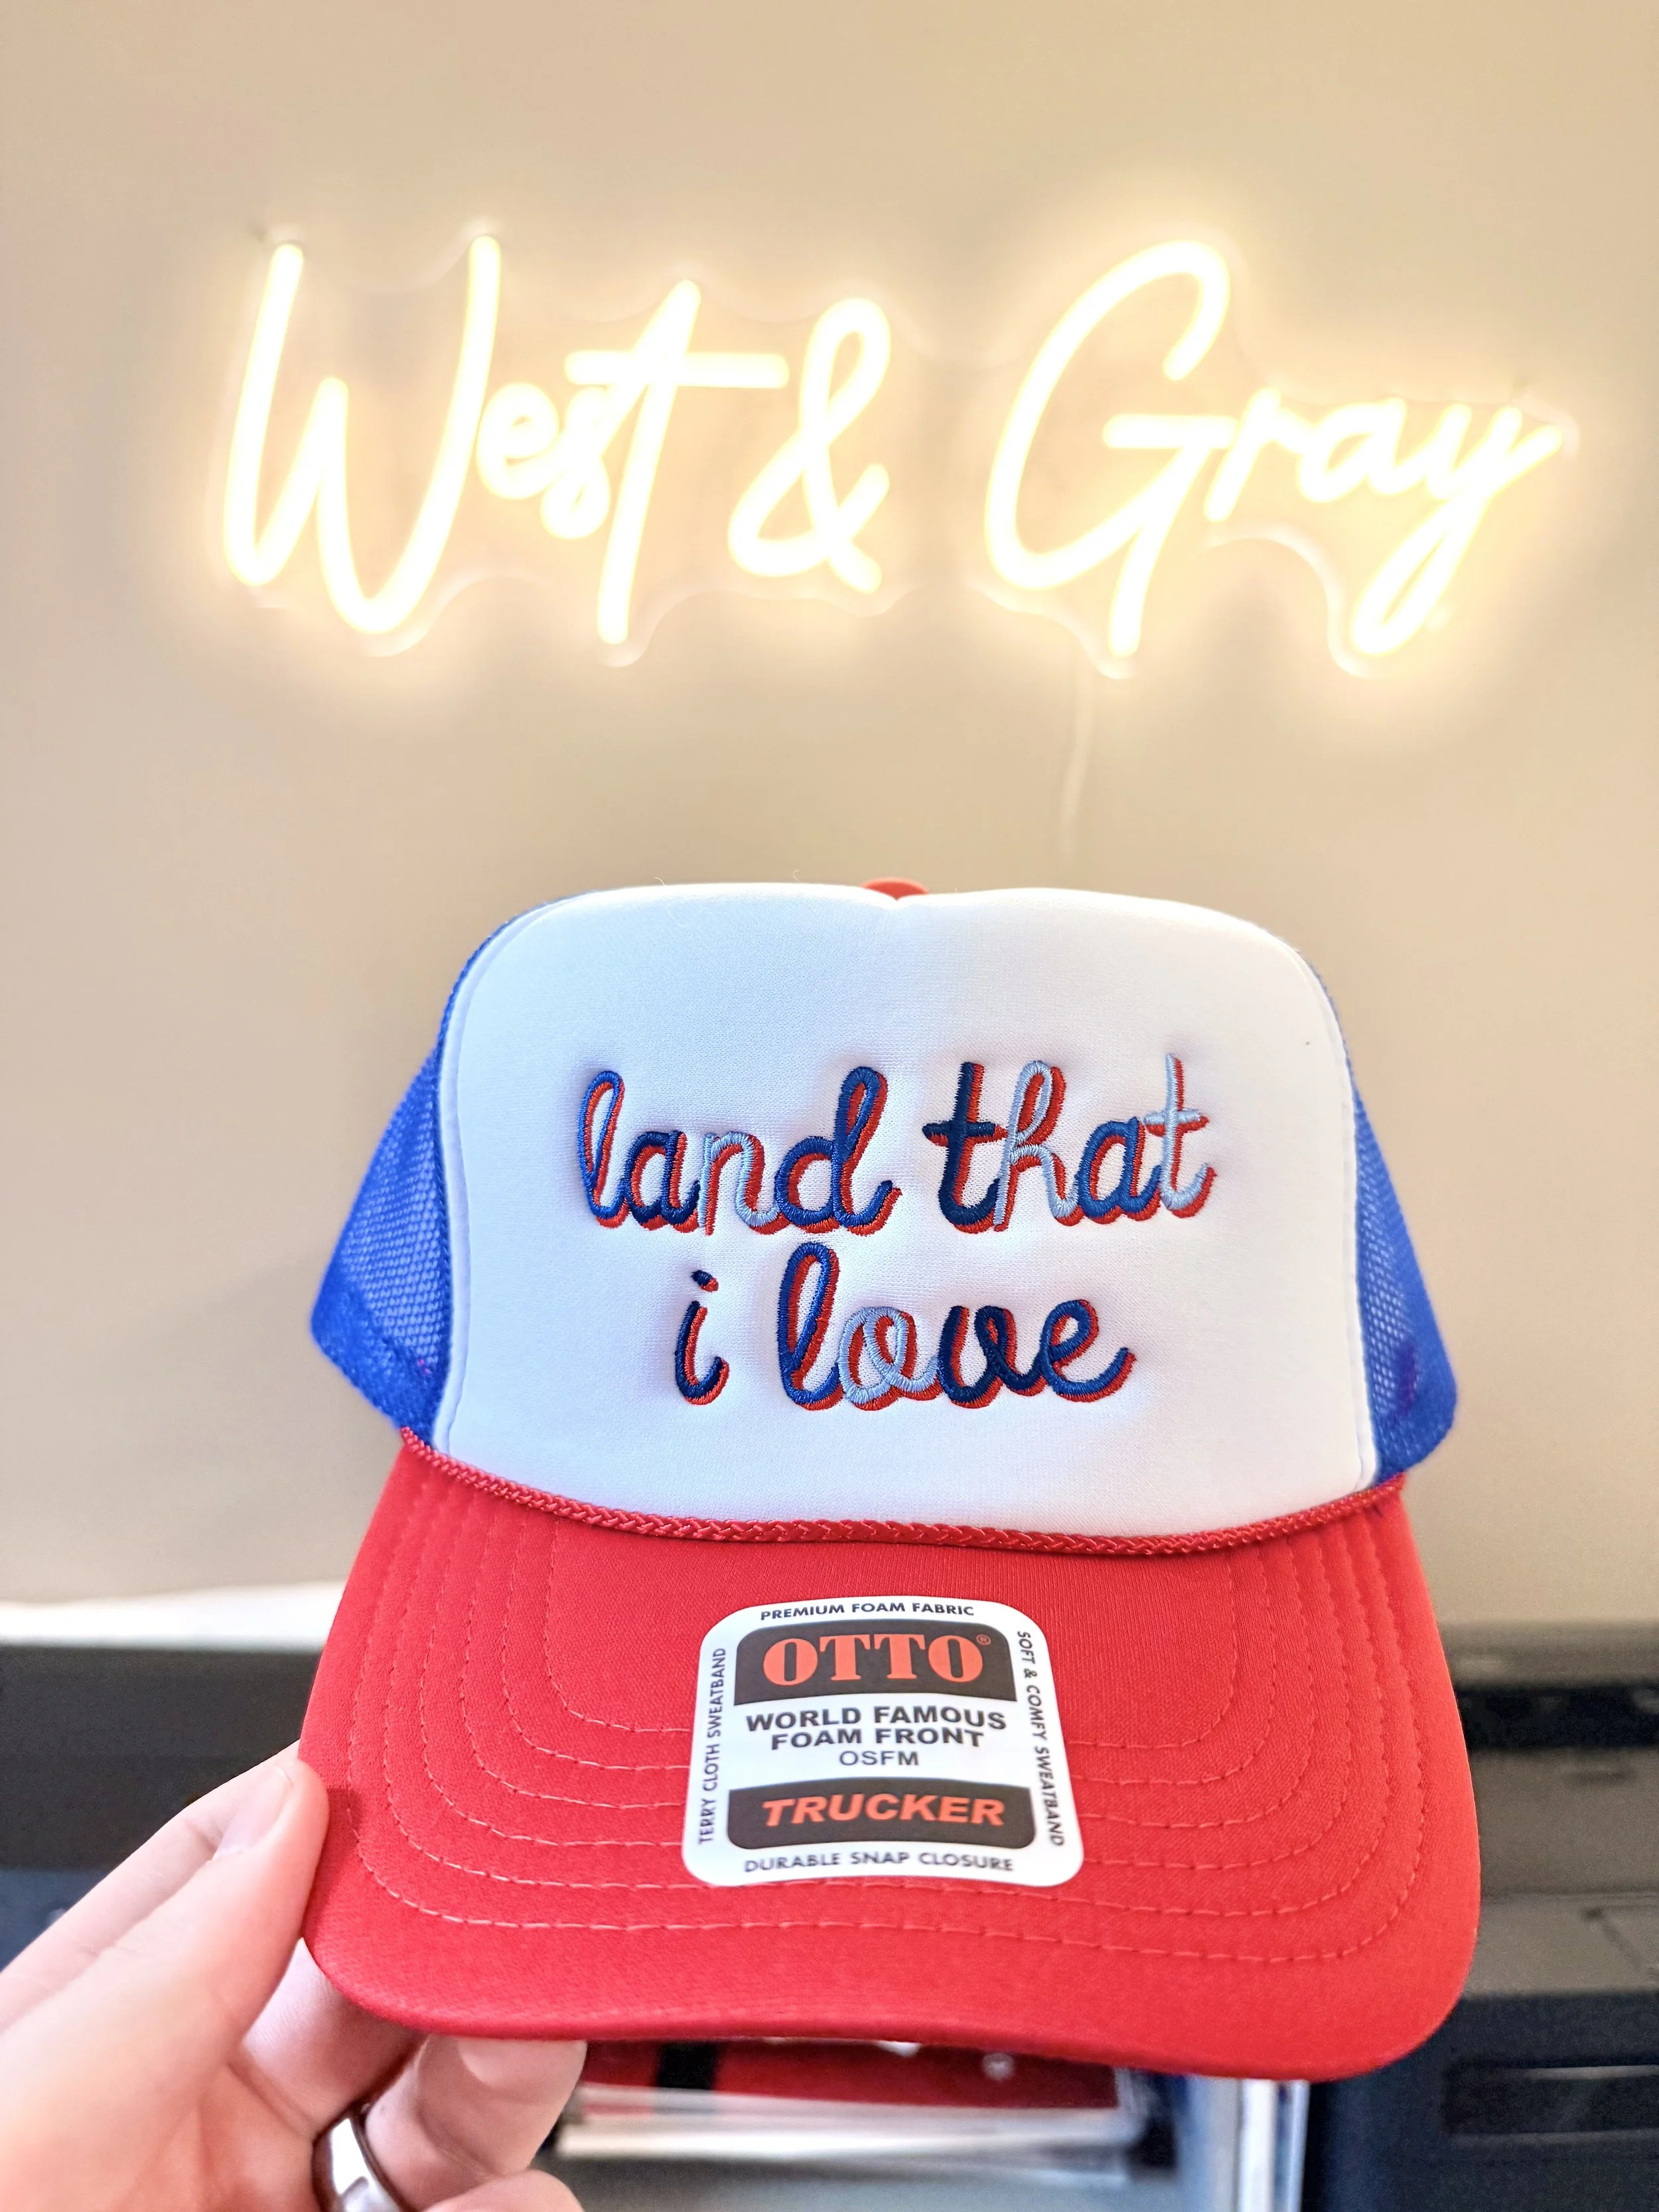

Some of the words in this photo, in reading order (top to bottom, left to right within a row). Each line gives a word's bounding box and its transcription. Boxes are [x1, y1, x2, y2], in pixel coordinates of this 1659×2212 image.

[224, 235, 790, 645] West
[727, 297, 891, 594] &
[984, 239, 1563, 656] Gray
[577, 1066, 902, 1236] land
[922, 1053, 1217, 1234] that
[675, 1269, 729, 1406] i
[777, 1240, 1137, 1411] love
[760, 1604, 845, 1621] PREMIUM
[851, 1602, 906, 1614] FOAM
[912, 1602, 975, 1617] FABRIC
[1017, 1631, 1036, 1664] SOFT
[707, 1647, 726, 1739] SWEATBAND
[1023, 1668, 1037, 1678] &
[746, 1707, 861, 1732] WORLD
[874, 1705, 1007, 1730] FAMOUS
[1026, 1684, 1048, 1741] COMFY
[771, 1728, 862, 1751] FOAM
[875, 1728, 984, 1747] FRONT
[839, 1751, 919, 1767] OSFM
[703, 1741, 720, 1792] CLOTH
[761, 1793, 1007, 1827] TRUCKER
[1035, 1745, 1064, 1846] SWEATBAND
[699, 1797, 717, 1845] TERRY
[744, 1852, 841, 1873] DURABLE
[849, 1852, 910, 1866] SNAP
[919, 1852, 1015, 1872] CLOSURE
